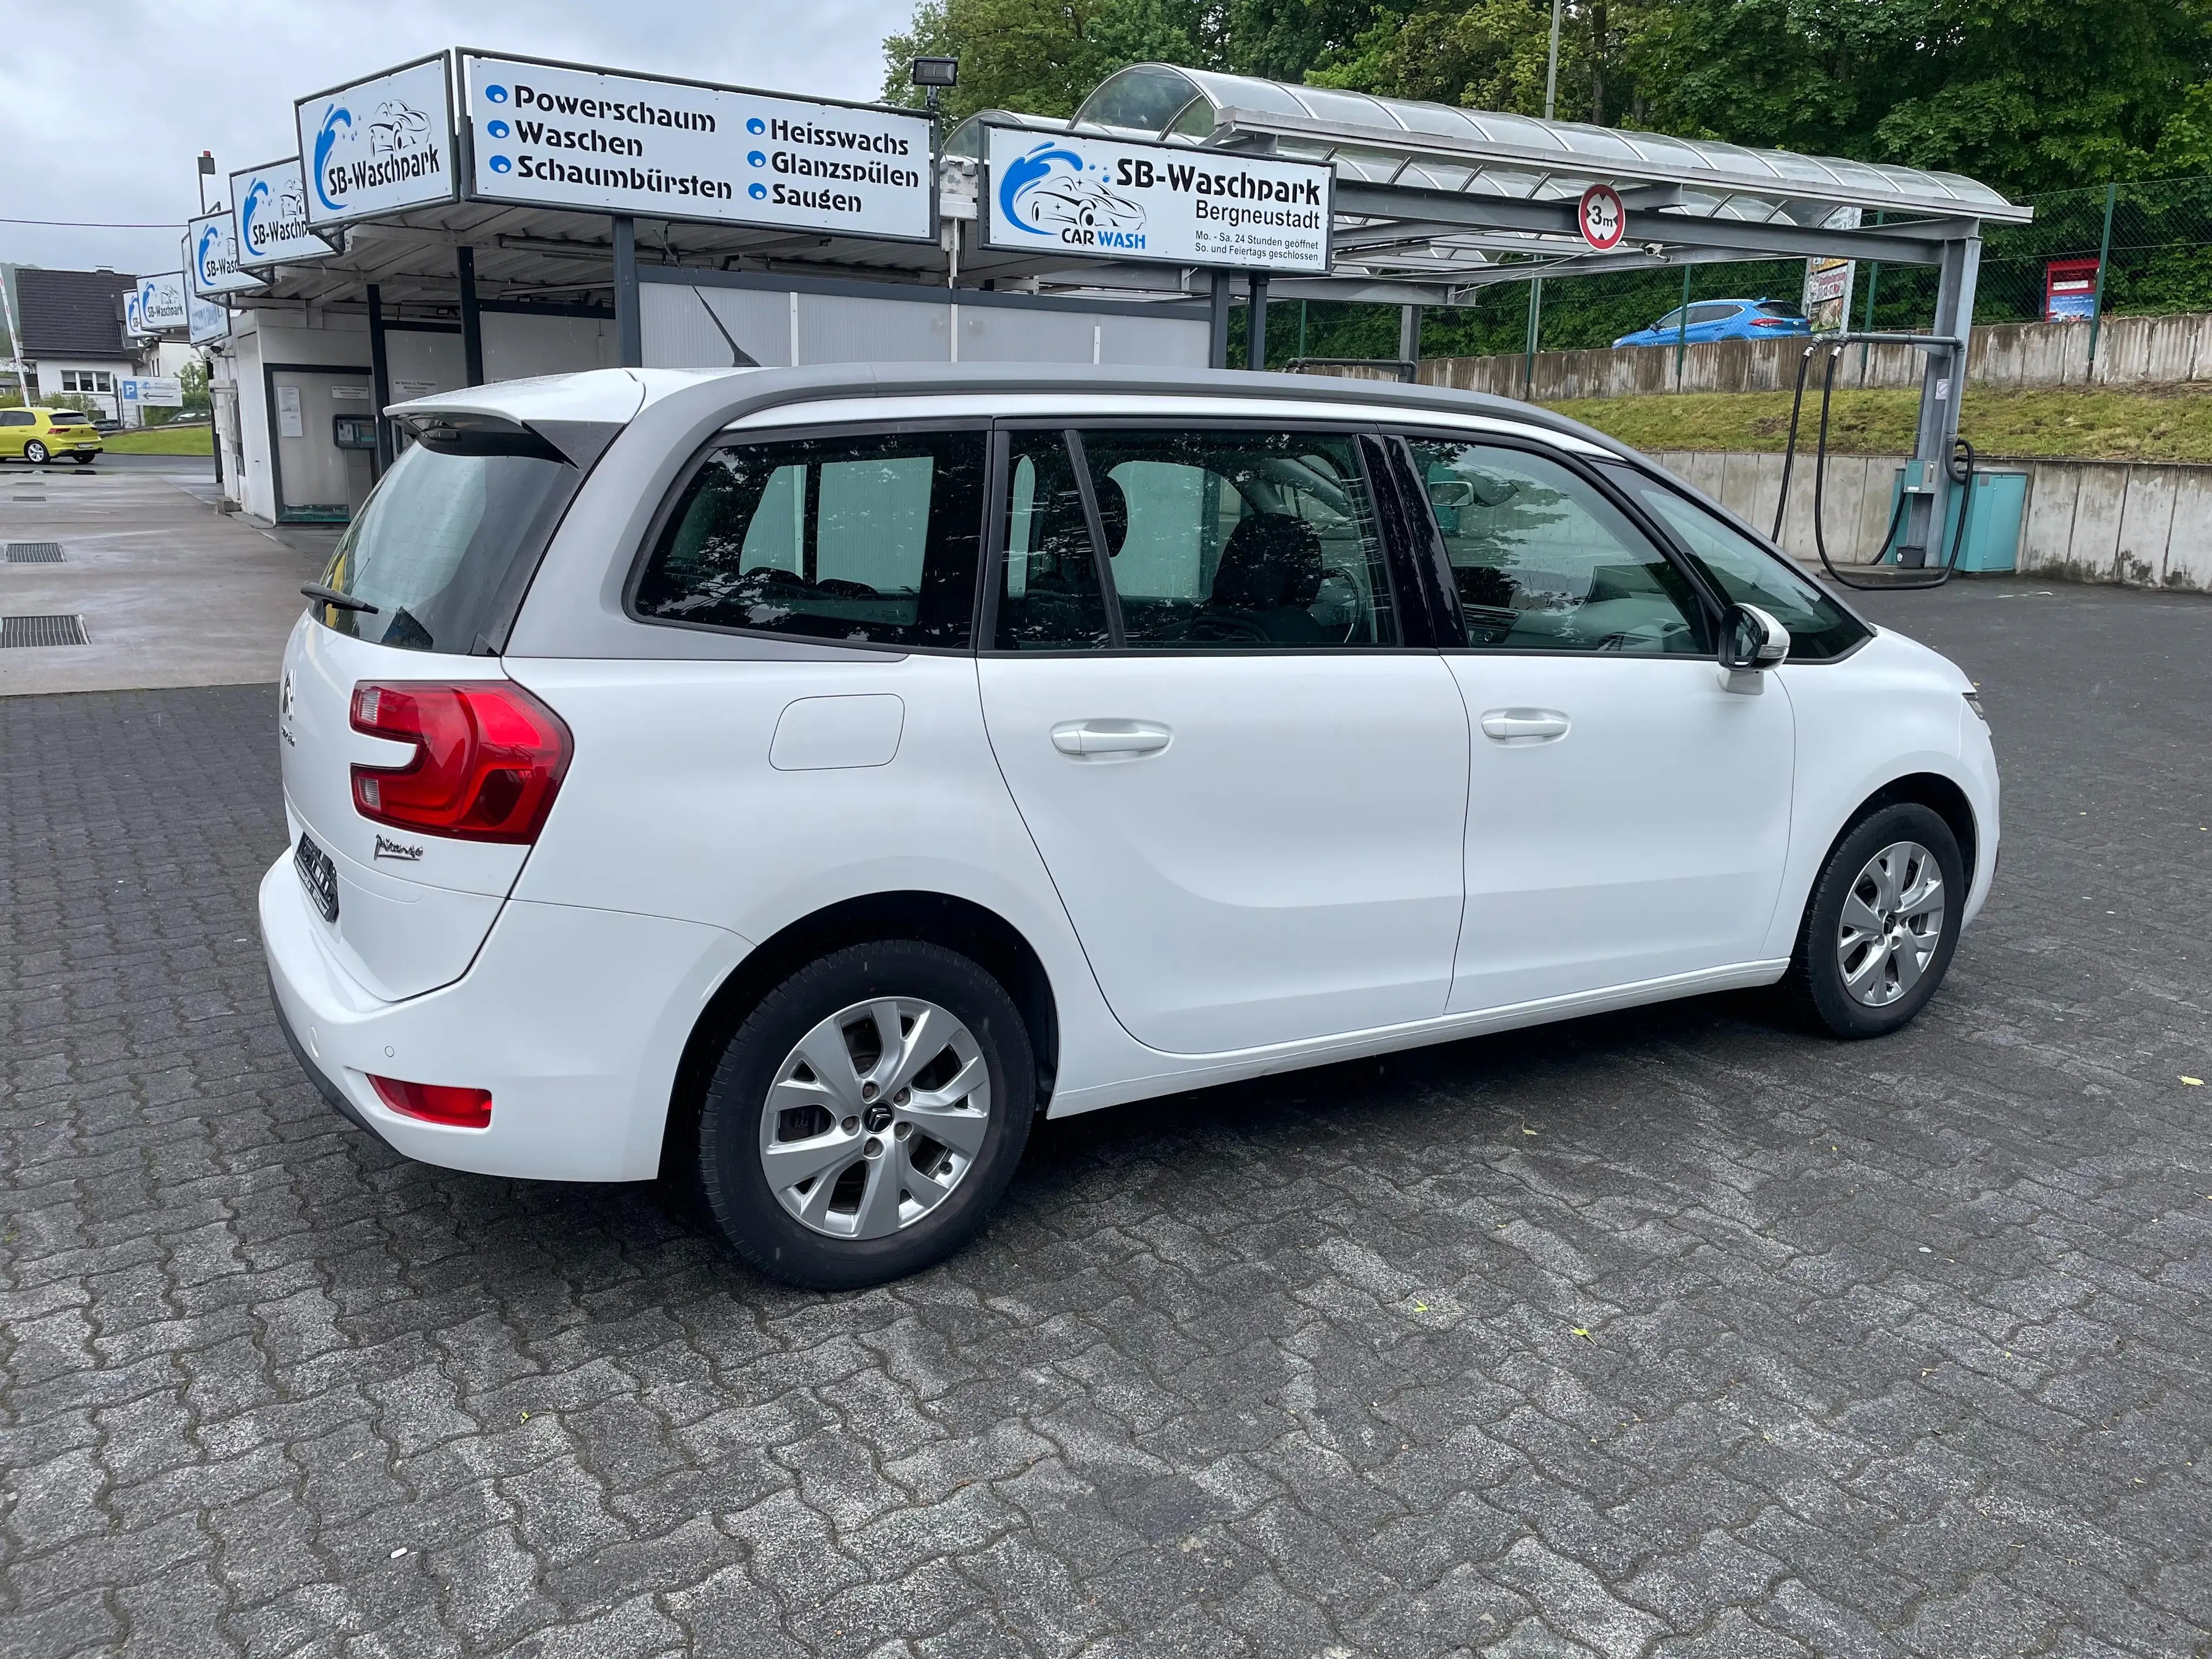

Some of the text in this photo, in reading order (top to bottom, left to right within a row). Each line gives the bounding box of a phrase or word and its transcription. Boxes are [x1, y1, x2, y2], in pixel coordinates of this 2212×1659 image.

[514, 85, 716, 132] Powerschaum
[514, 119, 643, 157] Waschen
[770, 119, 909, 156] Heisswachs
[328, 143, 440, 196] SB-Waschpark
[517, 155, 732, 200] Schaumbürsten
[771, 150, 920, 188] Glanzspülen
[1116, 157, 1321, 206] SB-Waschpark
[771, 183, 862, 213] Saugen
[1195, 199, 1320, 230] Bergneustadt
[1061, 228, 1146, 250] CAR WASH
[1195, 230, 1211, 240] Mo.
[1219, 232, 1233, 242] Sa.
[1234, 234, 1245, 243] 24
[1247, 234, 1282, 247] Stunden
[1285, 239, 1319, 250] geöffnet
[1195, 243, 1318, 261] So. und Feiertags geschlossen
[147, 303, 184, 317] SB-Waschpark
[126, 385, 135, 396] P
